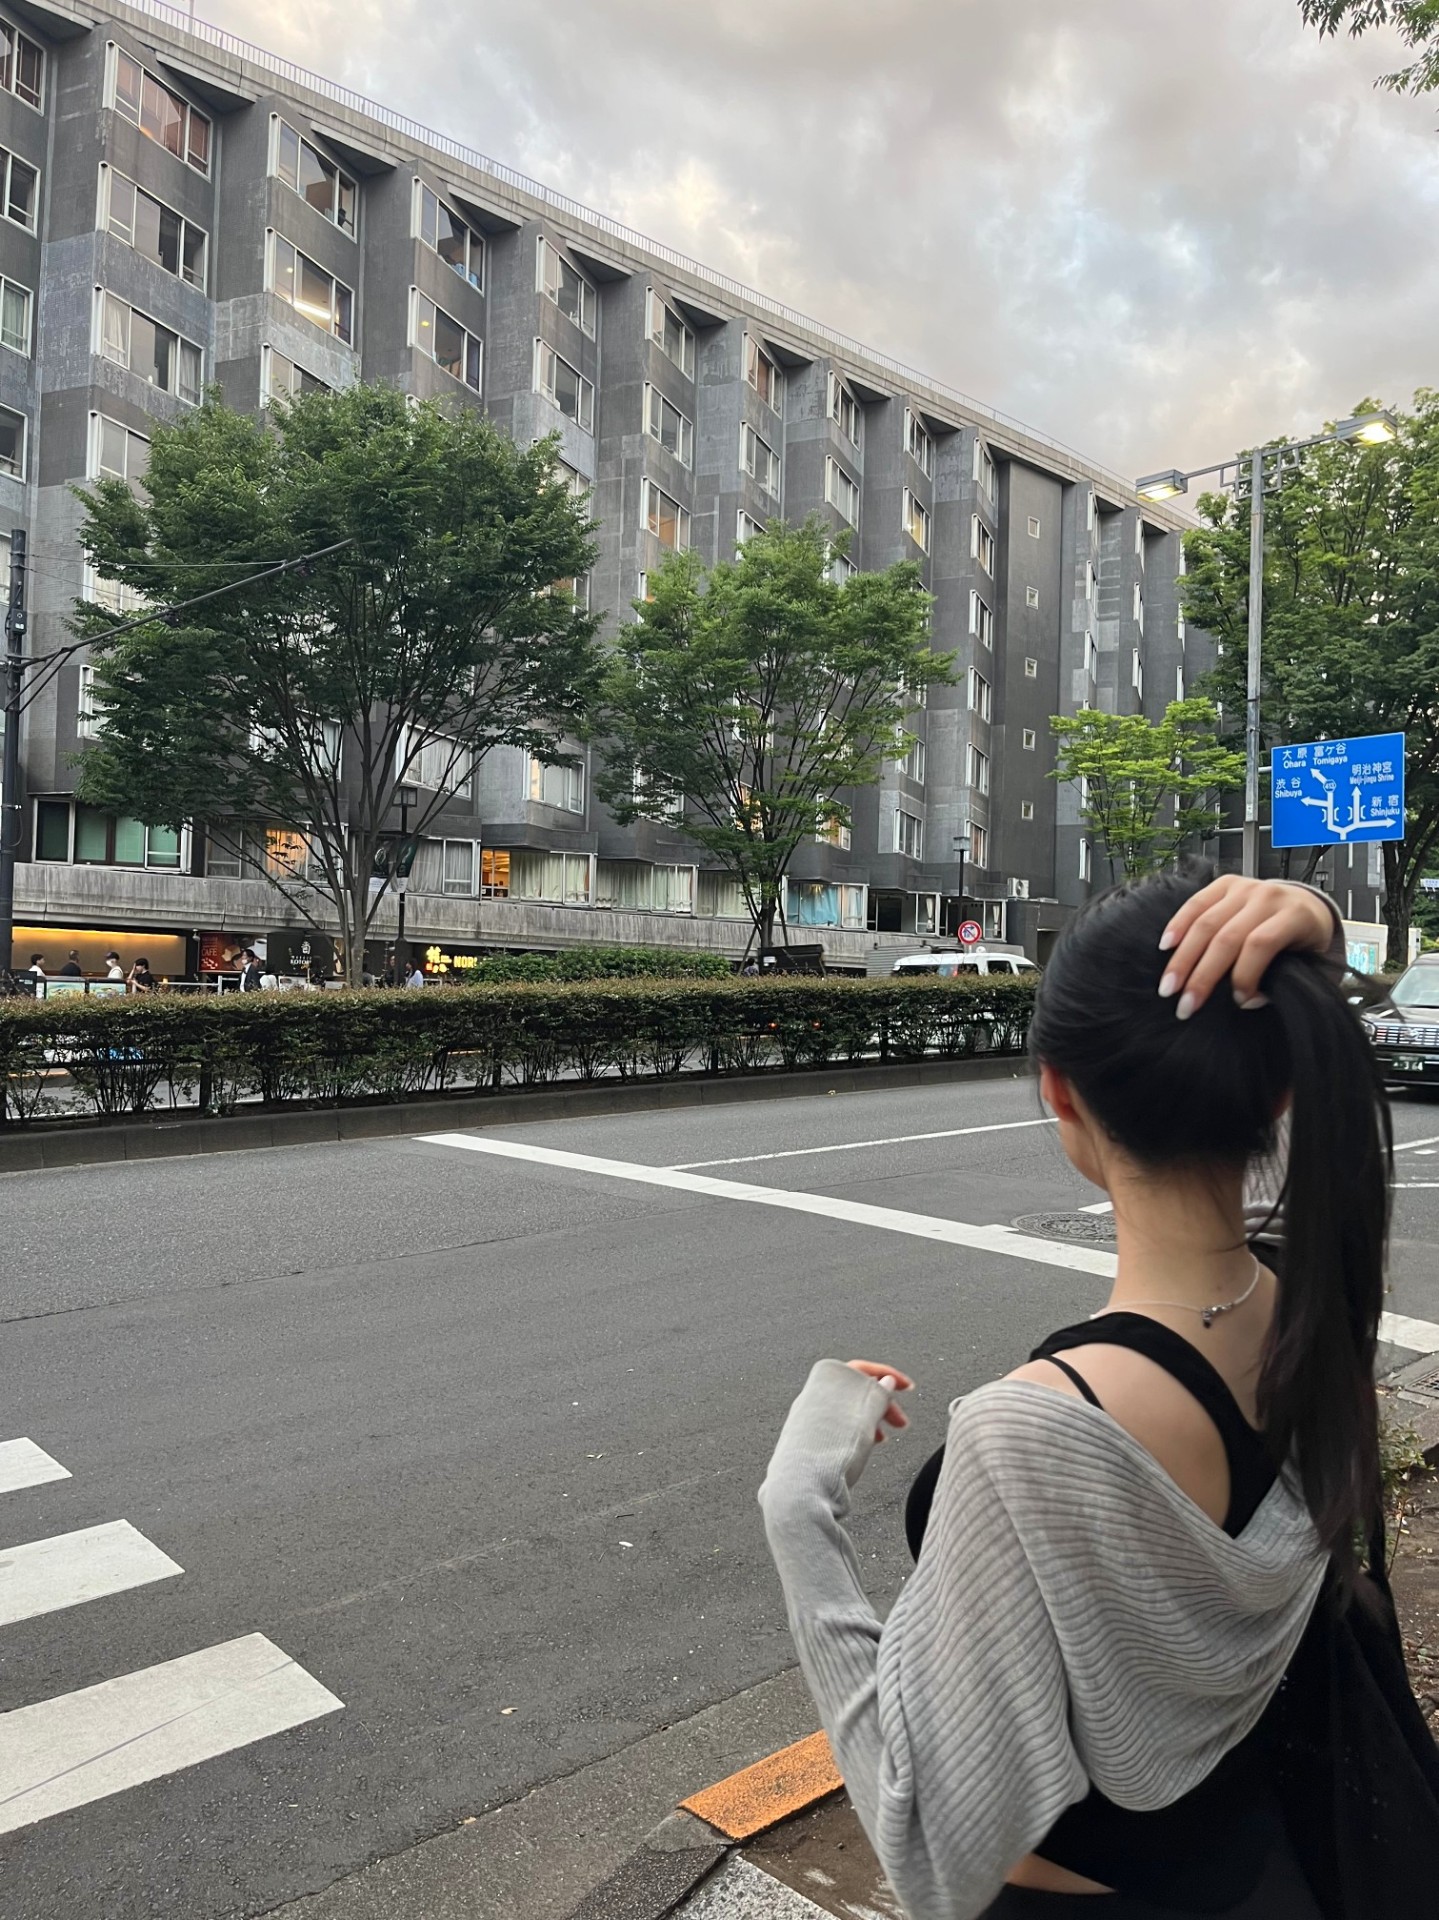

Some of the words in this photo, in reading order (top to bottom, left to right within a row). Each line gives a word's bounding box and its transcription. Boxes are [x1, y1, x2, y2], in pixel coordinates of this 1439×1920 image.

[1282, 747, 1308, 761] 大原
[1283, 760, 1307, 769] Ohara
[1313, 756, 1348, 766] Tomigaya
[1351, 761, 1393, 776] 明治神宮
[1275, 776, 1301, 790] 渋谷
[1377, 773, 1395, 782] Shrine
[1274, 789, 1303, 799] Shibuya
[1371, 794, 1399, 808] 新宿
[1370, 806, 1400, 817] Shinjuku
[202, 947, 218, 957] CAFE
